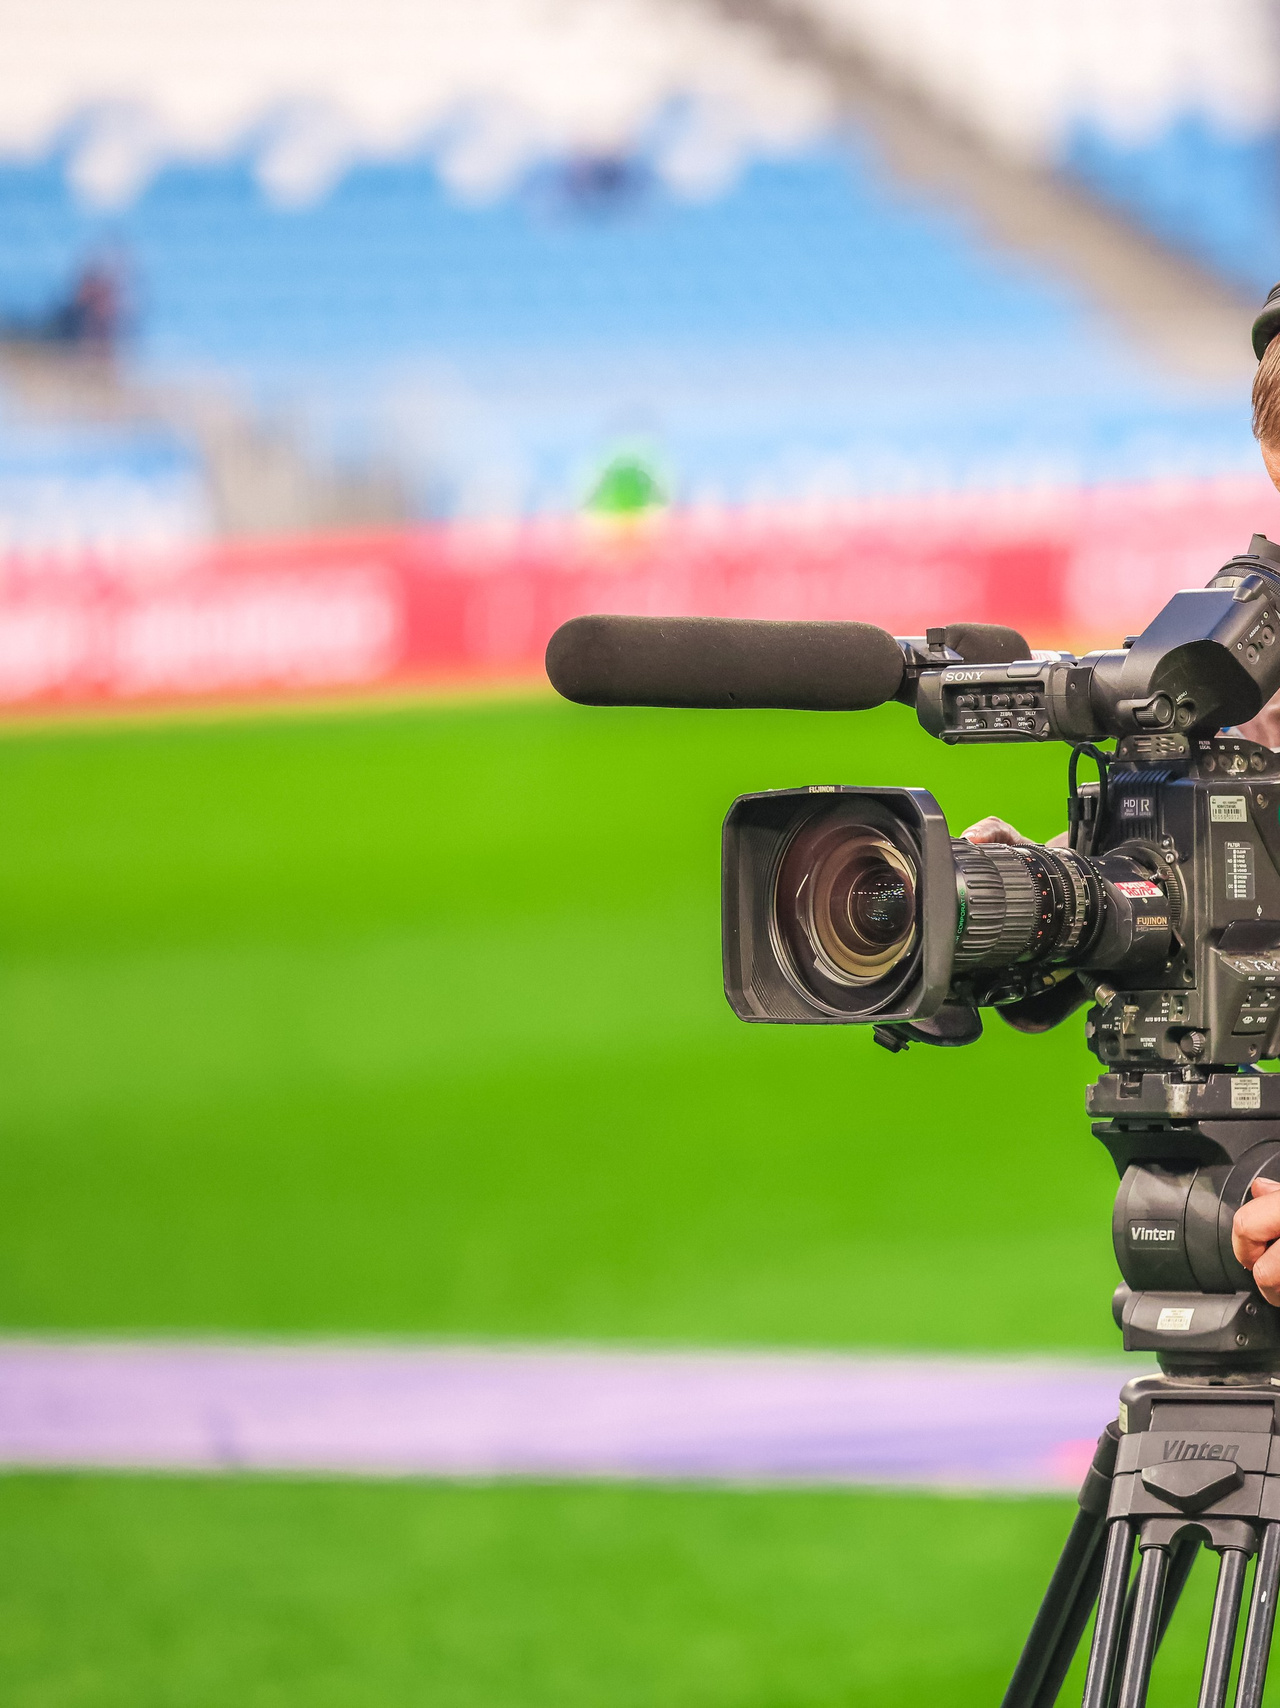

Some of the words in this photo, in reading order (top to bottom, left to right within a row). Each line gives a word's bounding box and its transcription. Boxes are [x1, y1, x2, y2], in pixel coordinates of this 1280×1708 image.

[945, 671, 985, 682] SONY
[1176, 690, 1188, 702] MENU
[808, 785, 836, 794] FUJINON
[1123, 799, 1136, 808] HD
[1140, 799, 1150, 812] R
[957, 889, 966, 934] CORPORATIO
[1137, 917, 1168, 926] FUJINON
[1131, 1226, 1176, 1241] Vinten
[1162, 1440, 1240, 1461] Vinten
